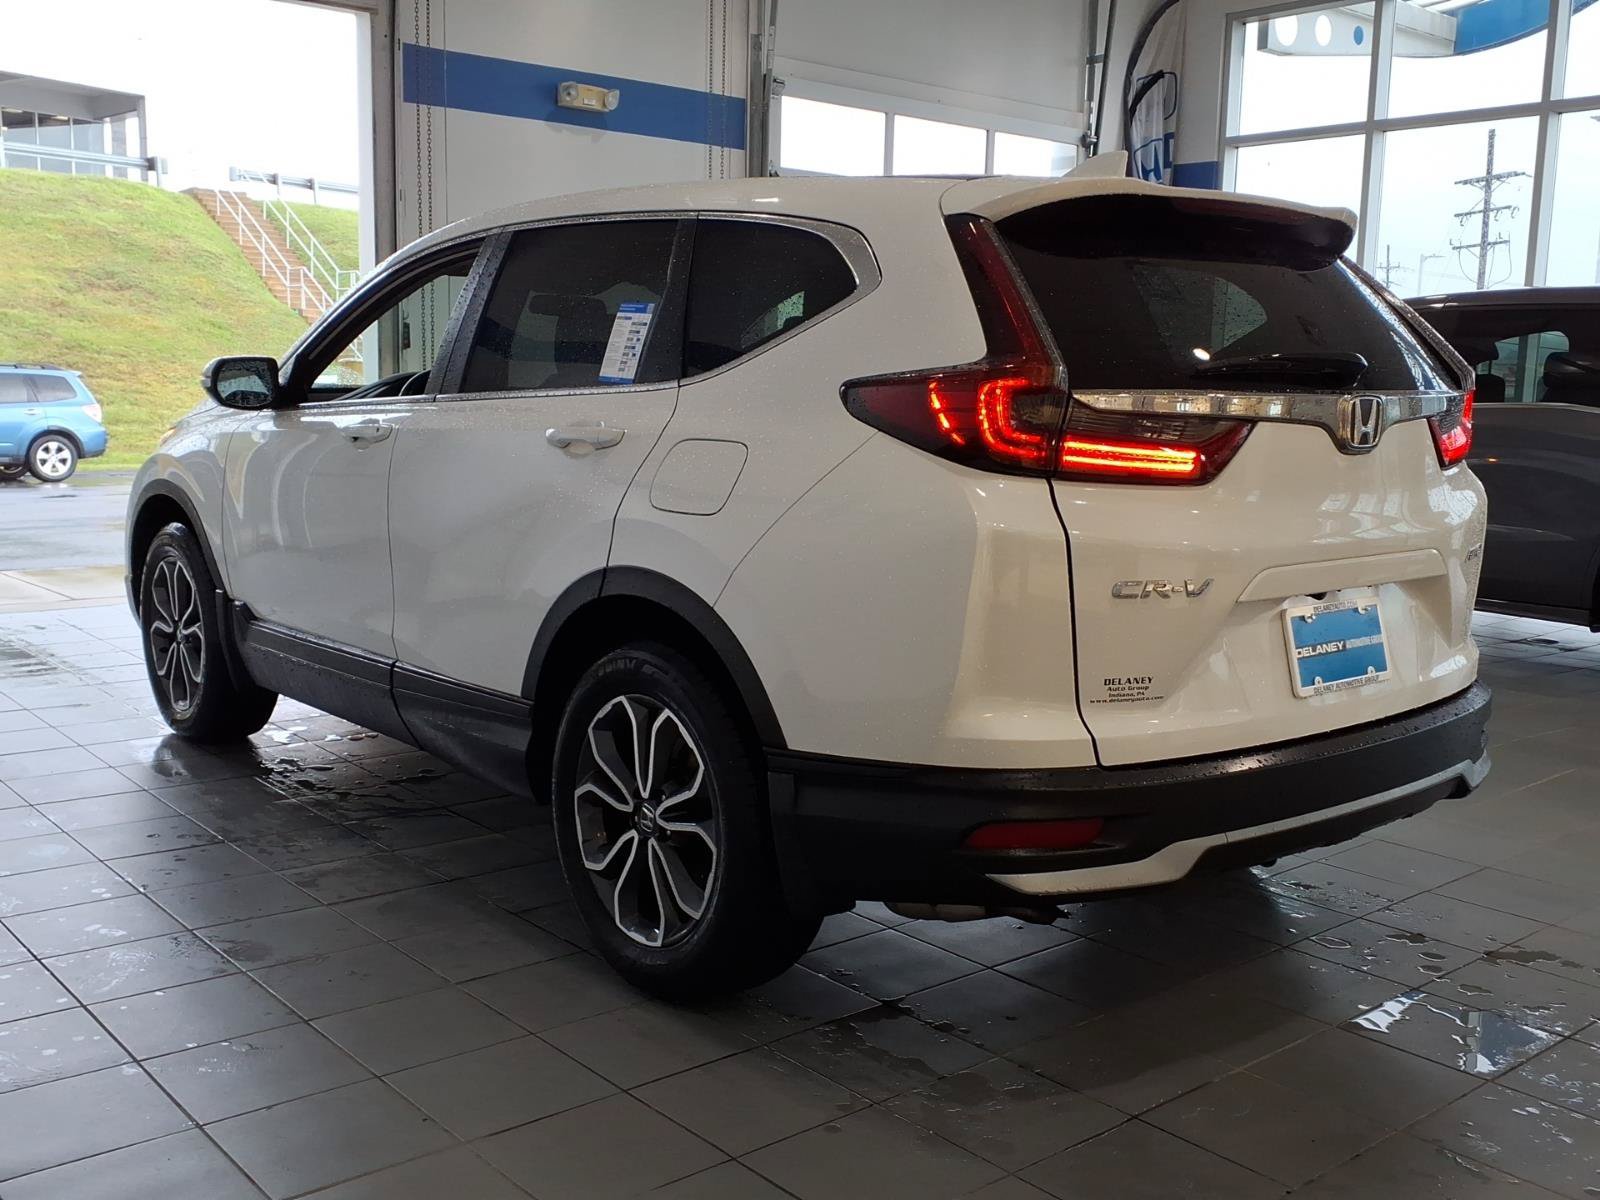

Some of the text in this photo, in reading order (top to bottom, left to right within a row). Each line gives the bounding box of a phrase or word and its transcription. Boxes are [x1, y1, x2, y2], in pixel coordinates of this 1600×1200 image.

[1111, 578, 1213, 600] CR-V
[1296, 641, 1344, 658] DELANEY
[1103, 676, 1153, 686] DELANEY
